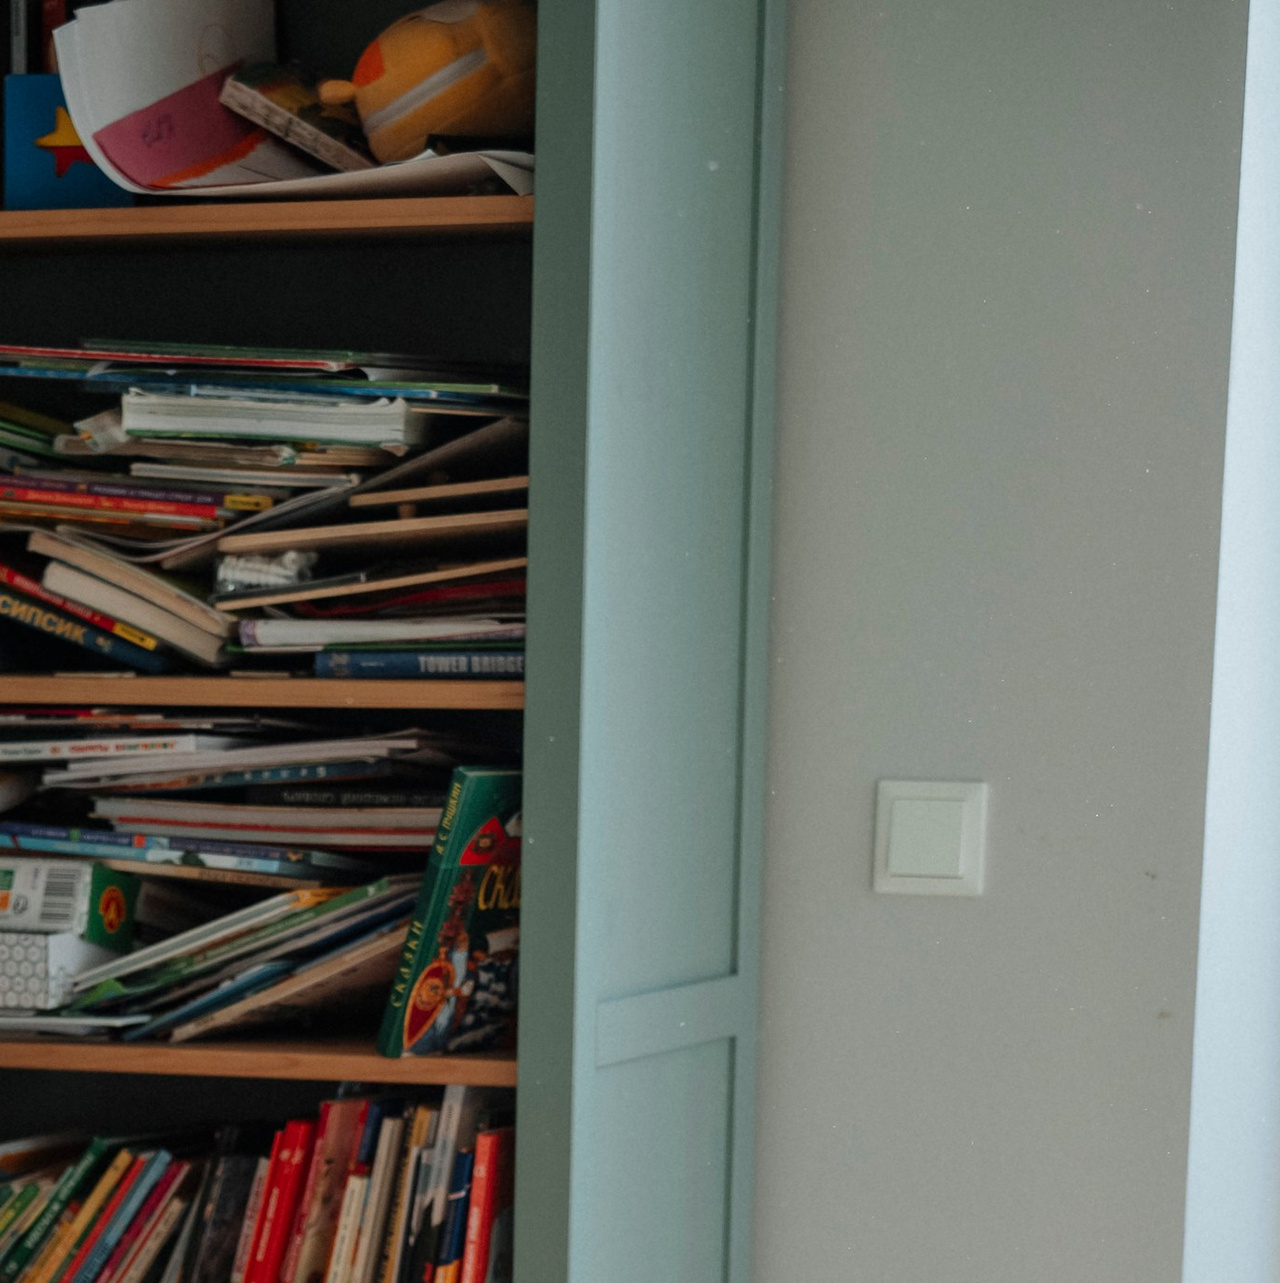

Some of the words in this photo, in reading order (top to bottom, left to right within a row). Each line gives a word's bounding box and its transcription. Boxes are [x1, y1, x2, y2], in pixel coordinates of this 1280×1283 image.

[418, 655, 468, 673] TOWER
[471, 655, 524, 673] BRIDGE
[391, 921, 422, 1007] СКАЗКИ
